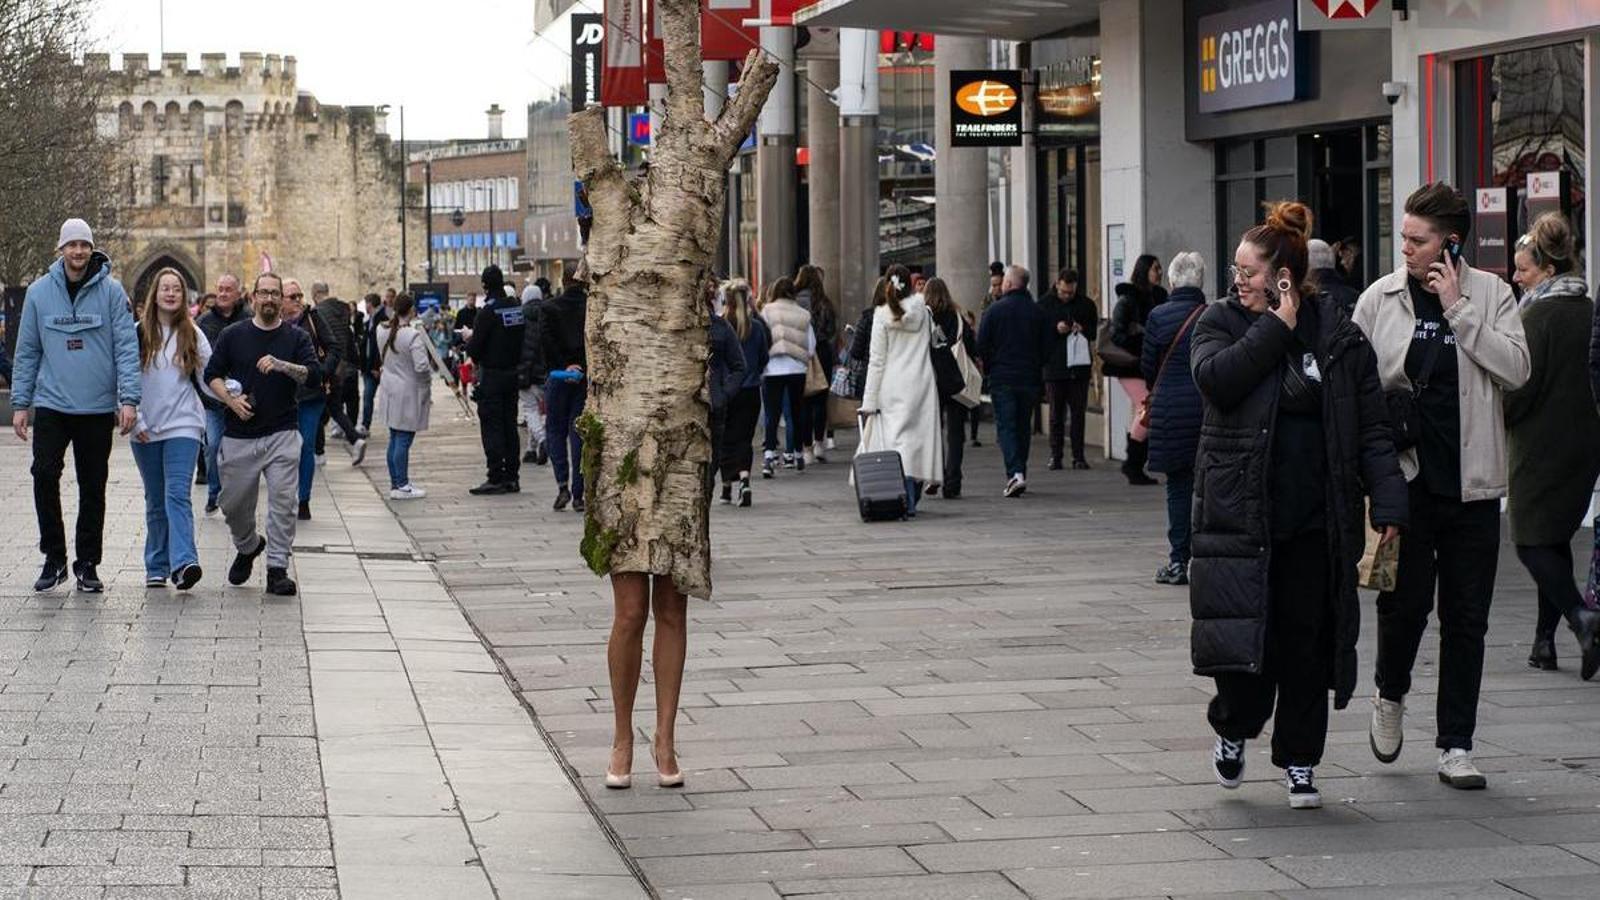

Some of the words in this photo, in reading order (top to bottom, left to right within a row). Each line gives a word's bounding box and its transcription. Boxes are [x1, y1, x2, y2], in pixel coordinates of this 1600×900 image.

[576, 23, 604, 44] JD
[1219, 18, 1290, 88] GREGGS
[956, 124, 1017, 132] TRAILFINDERS
